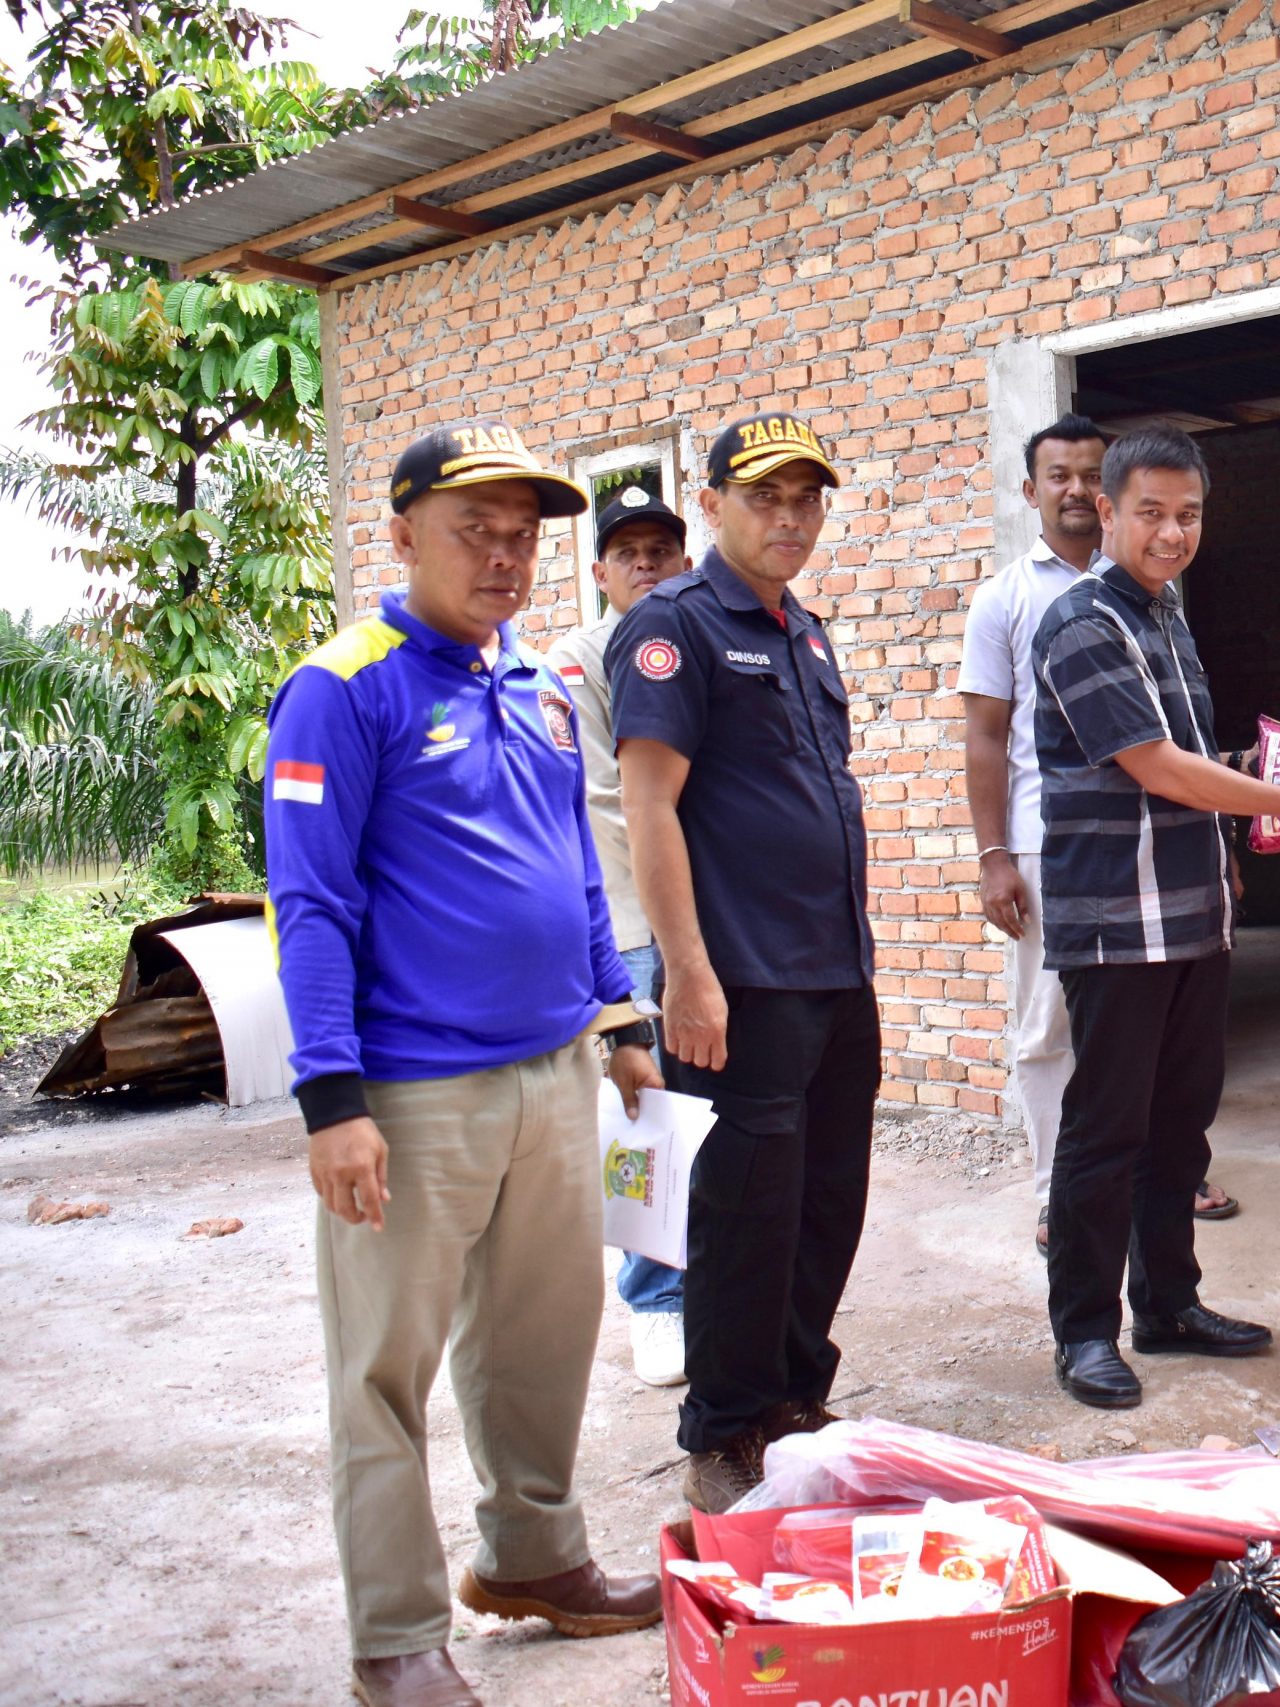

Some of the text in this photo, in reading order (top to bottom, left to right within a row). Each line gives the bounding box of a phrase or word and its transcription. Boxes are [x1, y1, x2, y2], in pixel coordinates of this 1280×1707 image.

[726, 650, 771, 665] DINSOS
[970, 1617, 1050, 1641] #KEMENSOS
[795, 1679, 1009, 1707] TUAN
